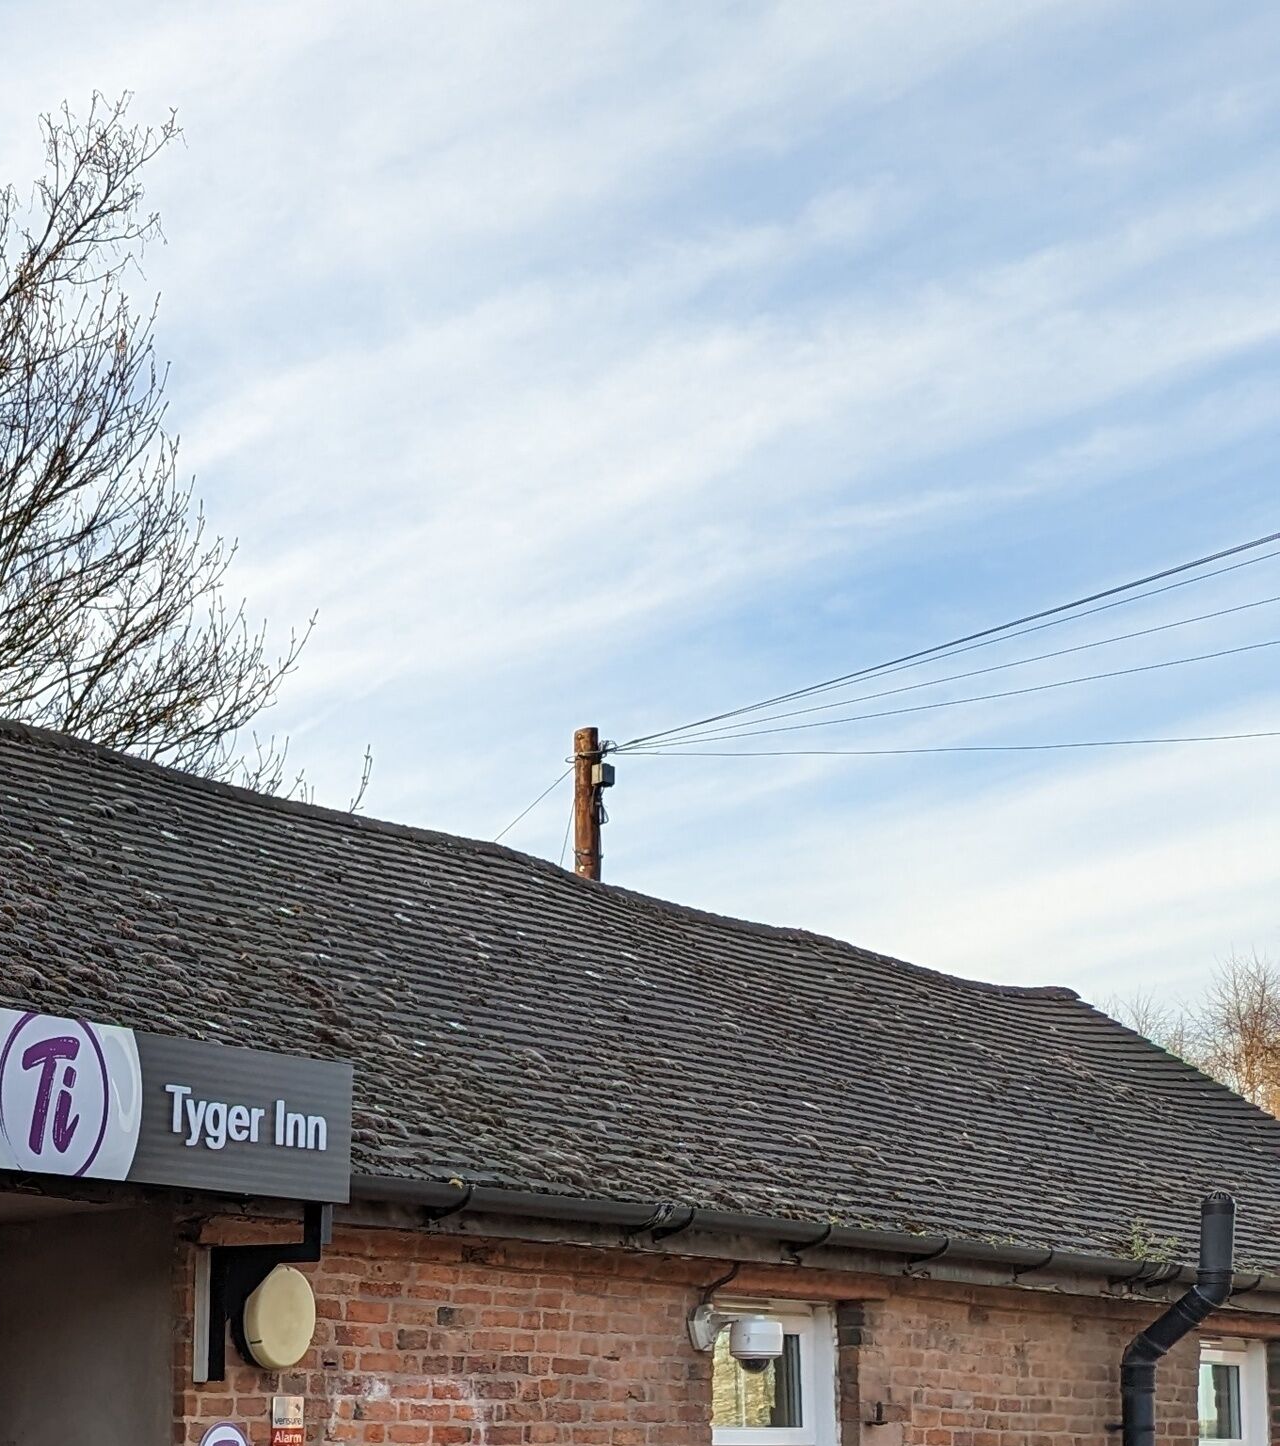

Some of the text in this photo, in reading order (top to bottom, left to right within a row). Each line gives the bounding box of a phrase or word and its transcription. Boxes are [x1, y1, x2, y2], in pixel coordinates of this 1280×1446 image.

[21, 1036, 81, 1155] Ti
[164, 1084, 328, 1152] Tyger Inn
[273, 1430, 302, 1443] Alarm
